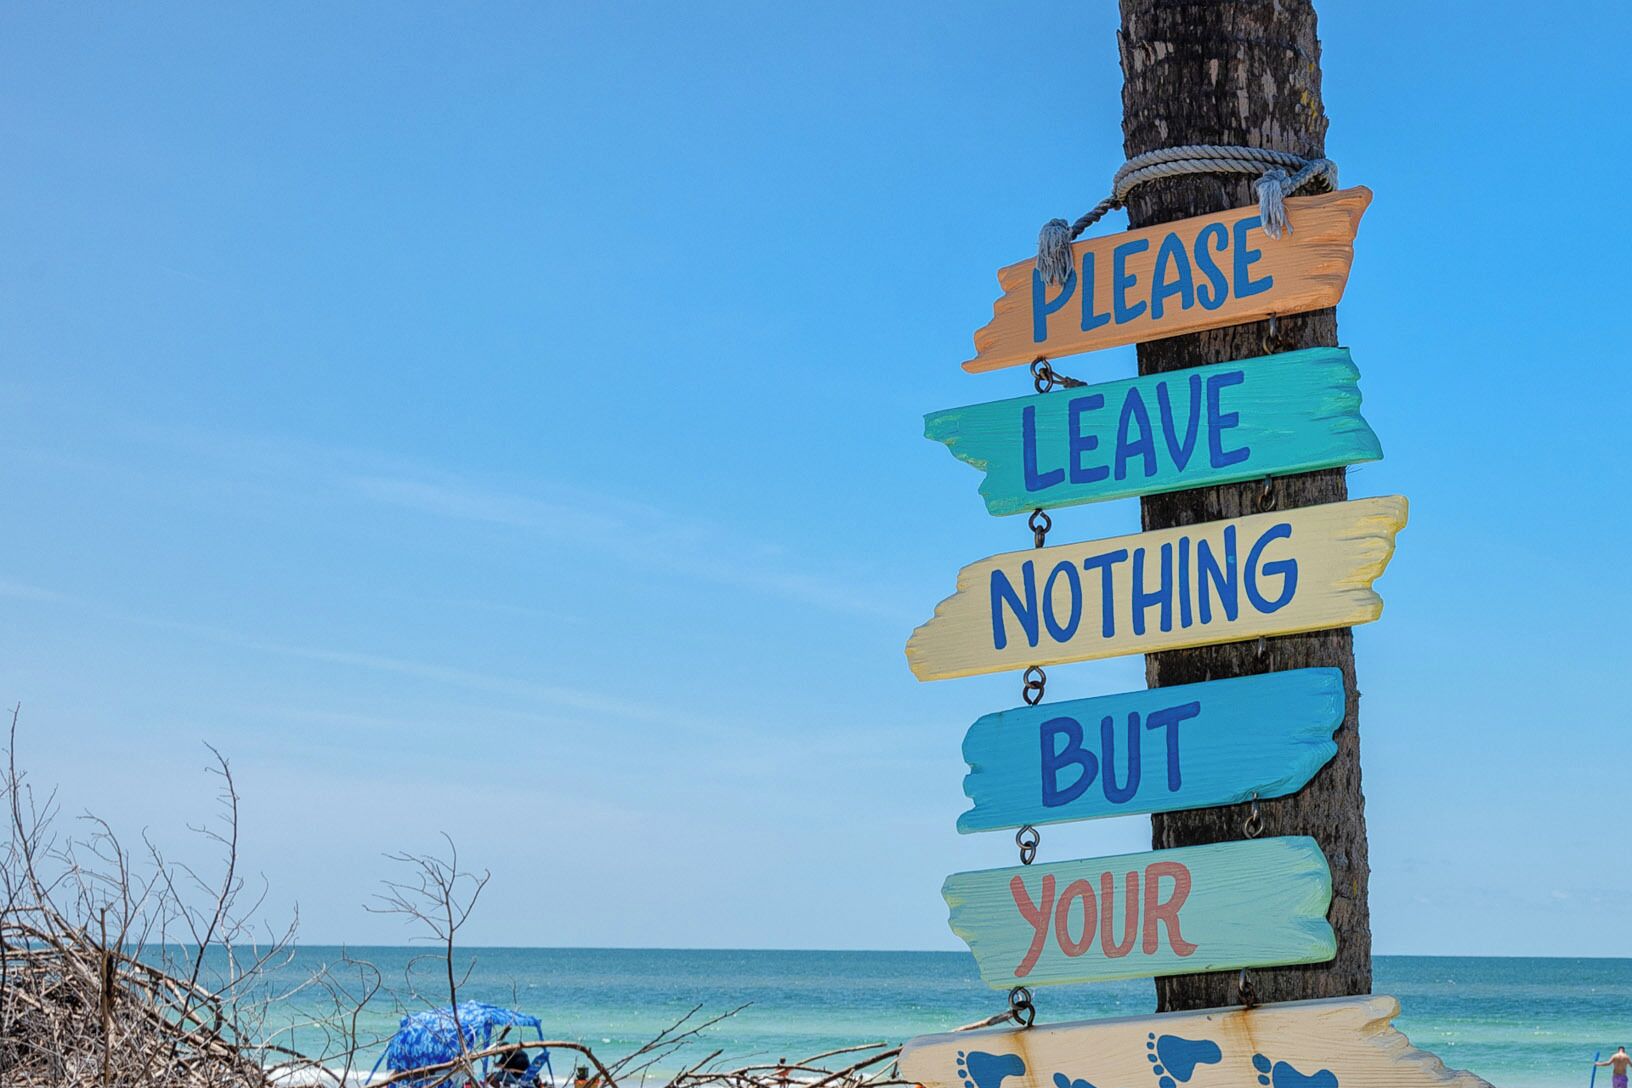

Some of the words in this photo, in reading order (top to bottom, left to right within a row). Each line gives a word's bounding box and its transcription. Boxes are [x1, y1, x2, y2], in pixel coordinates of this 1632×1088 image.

[1032, 215, 1273, 343] PLEASE
[1022, 370, 1251, 493] LEAVE
[990, 523, 1299, 650] NOTHING
[1040, 701, 1201, 808] BUT
[1010, 861, 1198, 978] YOUR
